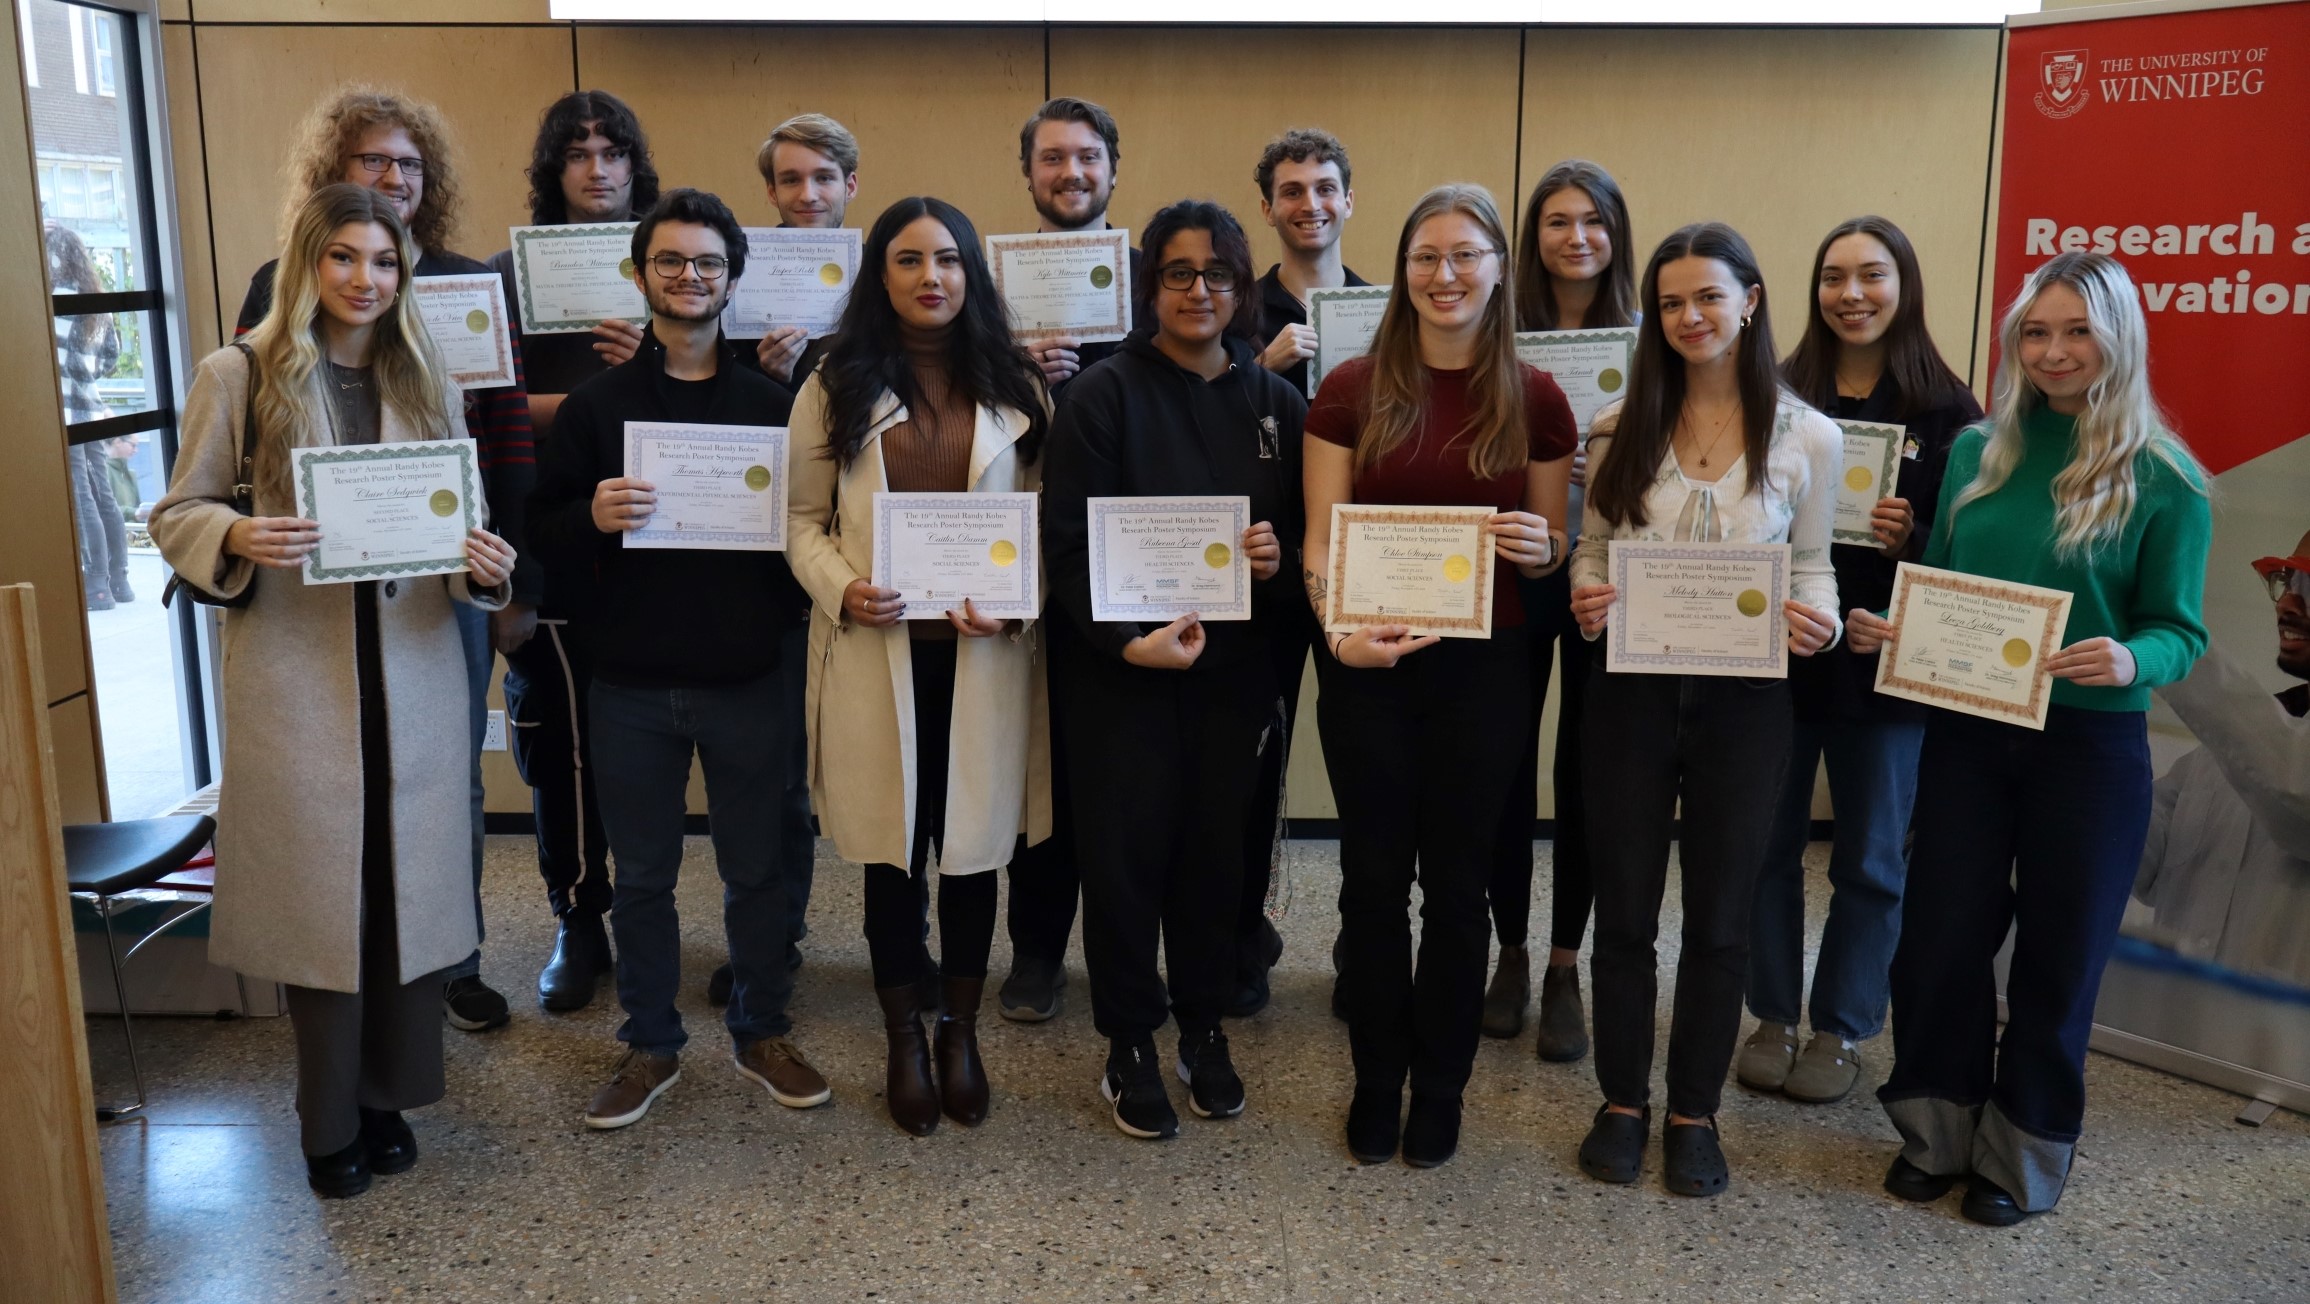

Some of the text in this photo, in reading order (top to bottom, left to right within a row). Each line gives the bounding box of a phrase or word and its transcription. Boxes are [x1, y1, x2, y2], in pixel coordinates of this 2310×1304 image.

[2101, 48, 2268, 72] THE UNIVERSITY OF
[2100, 69, 2265, 103] WINNIPEG
[2025, 212, 2275, 256] Research
[440, 301, 476, 309] Symposium
[1850, 439, 1870, 447] Kobes
[716, 454, 755, 462] Symposium
[330, 467, 346, 475] The
[365, 464, 393, 472] Annual
[395, 463, 419, 471] Randy
[334, 475, 369, 484] Research
[398, 472, 442, 481] Symposium
[962, 512, 983, 520] Randy
[1175, 517, 1197, 525] Randy
[964, 522, 1004, 530] Symposium
[1177, 526, 1216, 534] Symposium
[1419, 536, 1459, 544] Symposium
[1643, 562, 1657, 570] The
[1706, 564, 1730, 572] Randy
[1646, 572, 1679, 580] Research
[1708, 574, 1752, 583] Symposium
[1923, 587, 1937, 596] The
[1955, 594, 1980, 605] Annual
[1982, 599, 2006, 611] Randy
[2008, 605, 2031, 614] Kobes
[1924, 598, 2025, 624] Research Poster Symposium
